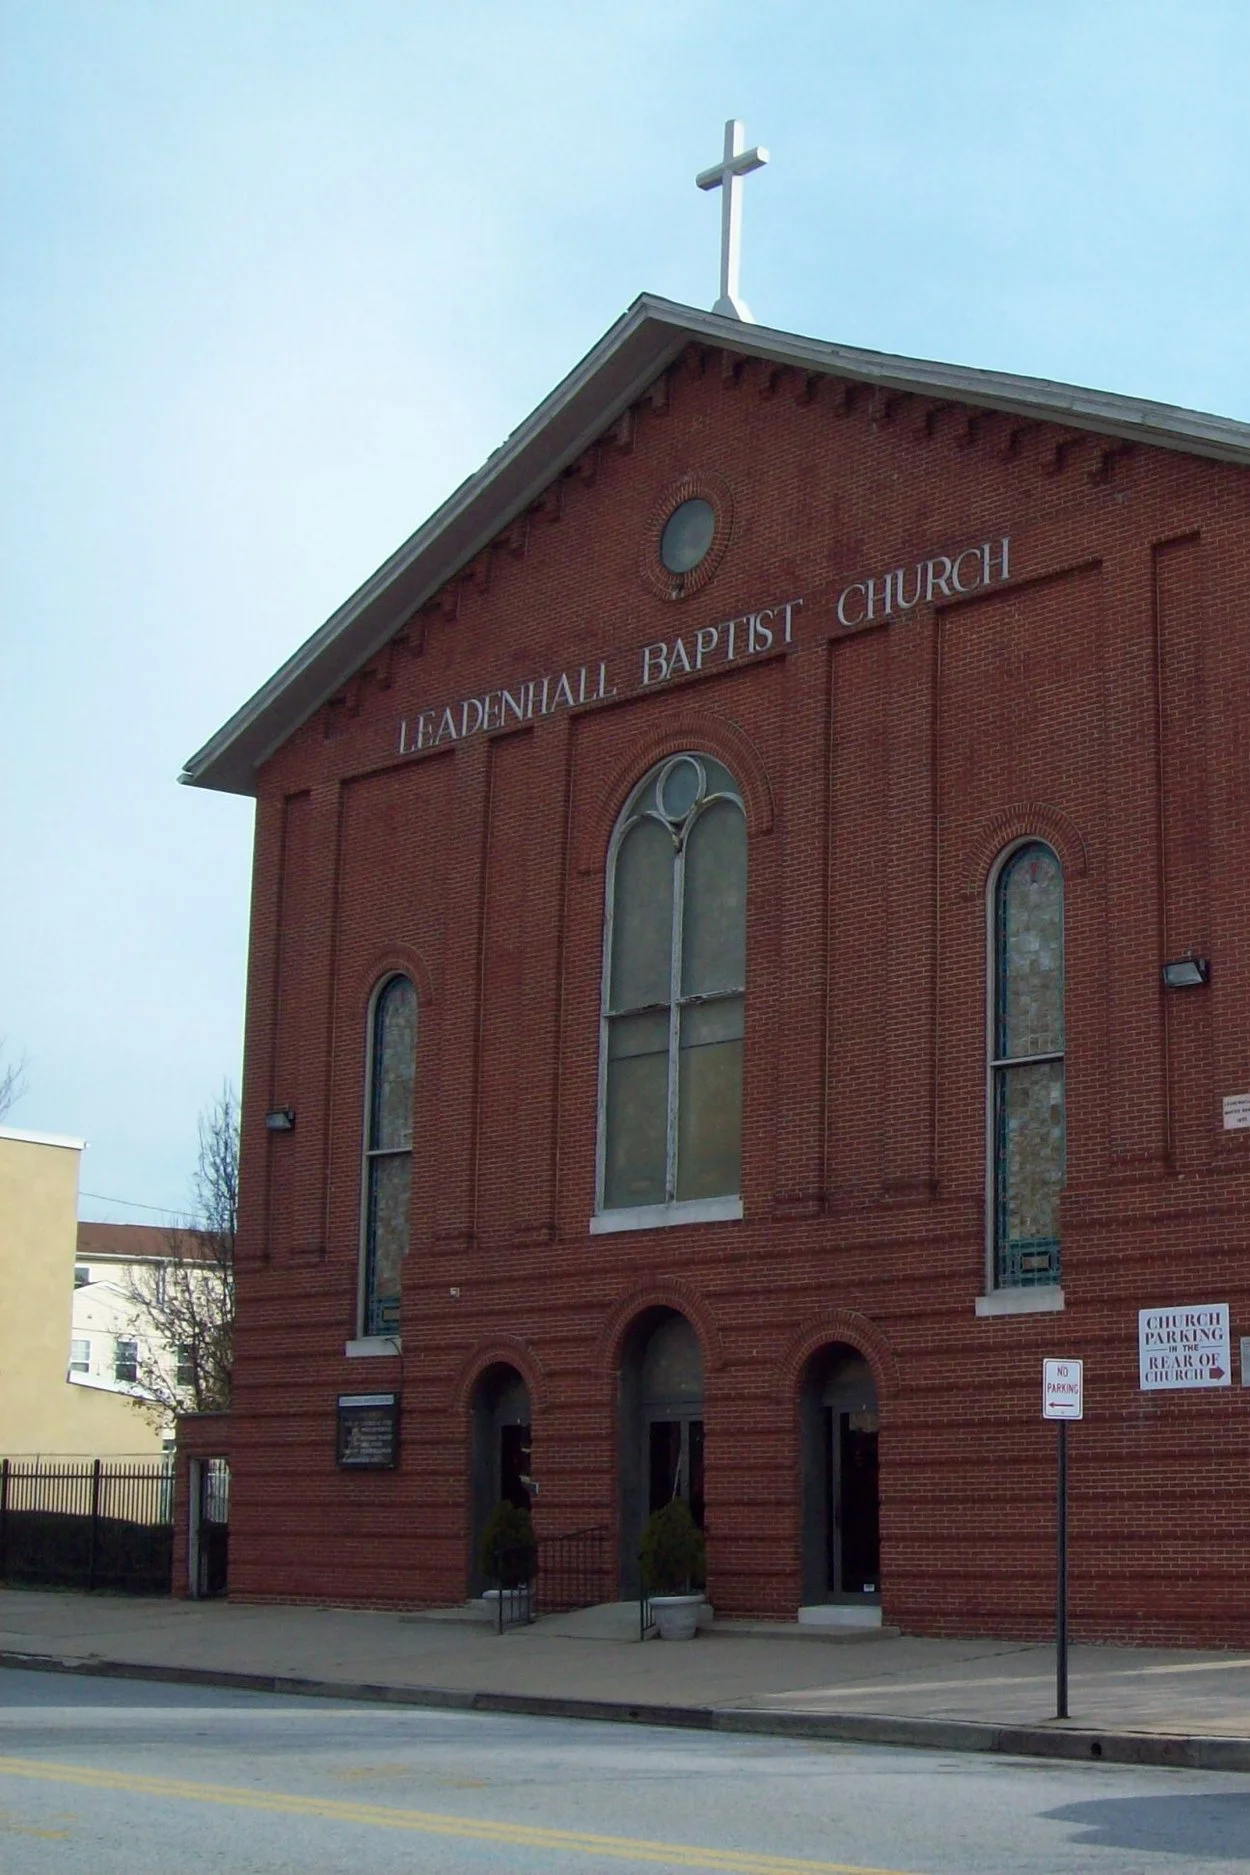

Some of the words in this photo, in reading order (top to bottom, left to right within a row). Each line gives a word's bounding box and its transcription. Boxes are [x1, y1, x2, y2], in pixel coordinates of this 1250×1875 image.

[398, 661, 617, 754] LEADENHALL
[641, 598, 803, 686] BAPTIST
[837, 537, 1012, 628] CHURCH
[1146, 1312, 1221, 1329] CHURCH
[1145, 1328, 1223, 1345] PARKING
[1168, 1345, 1178, 1353] IN
[1182, 1344, 1200, 1353] THE
[1149, 1355, 1193, 1370] REAR
[1198, 1353, 1221, 1367] OF
[1056, 1366, 1069, 1377] NO
[1145, 1368, 1204, 1382] CHURCH
[1047, 1382, 1079, 1394] PARKING
